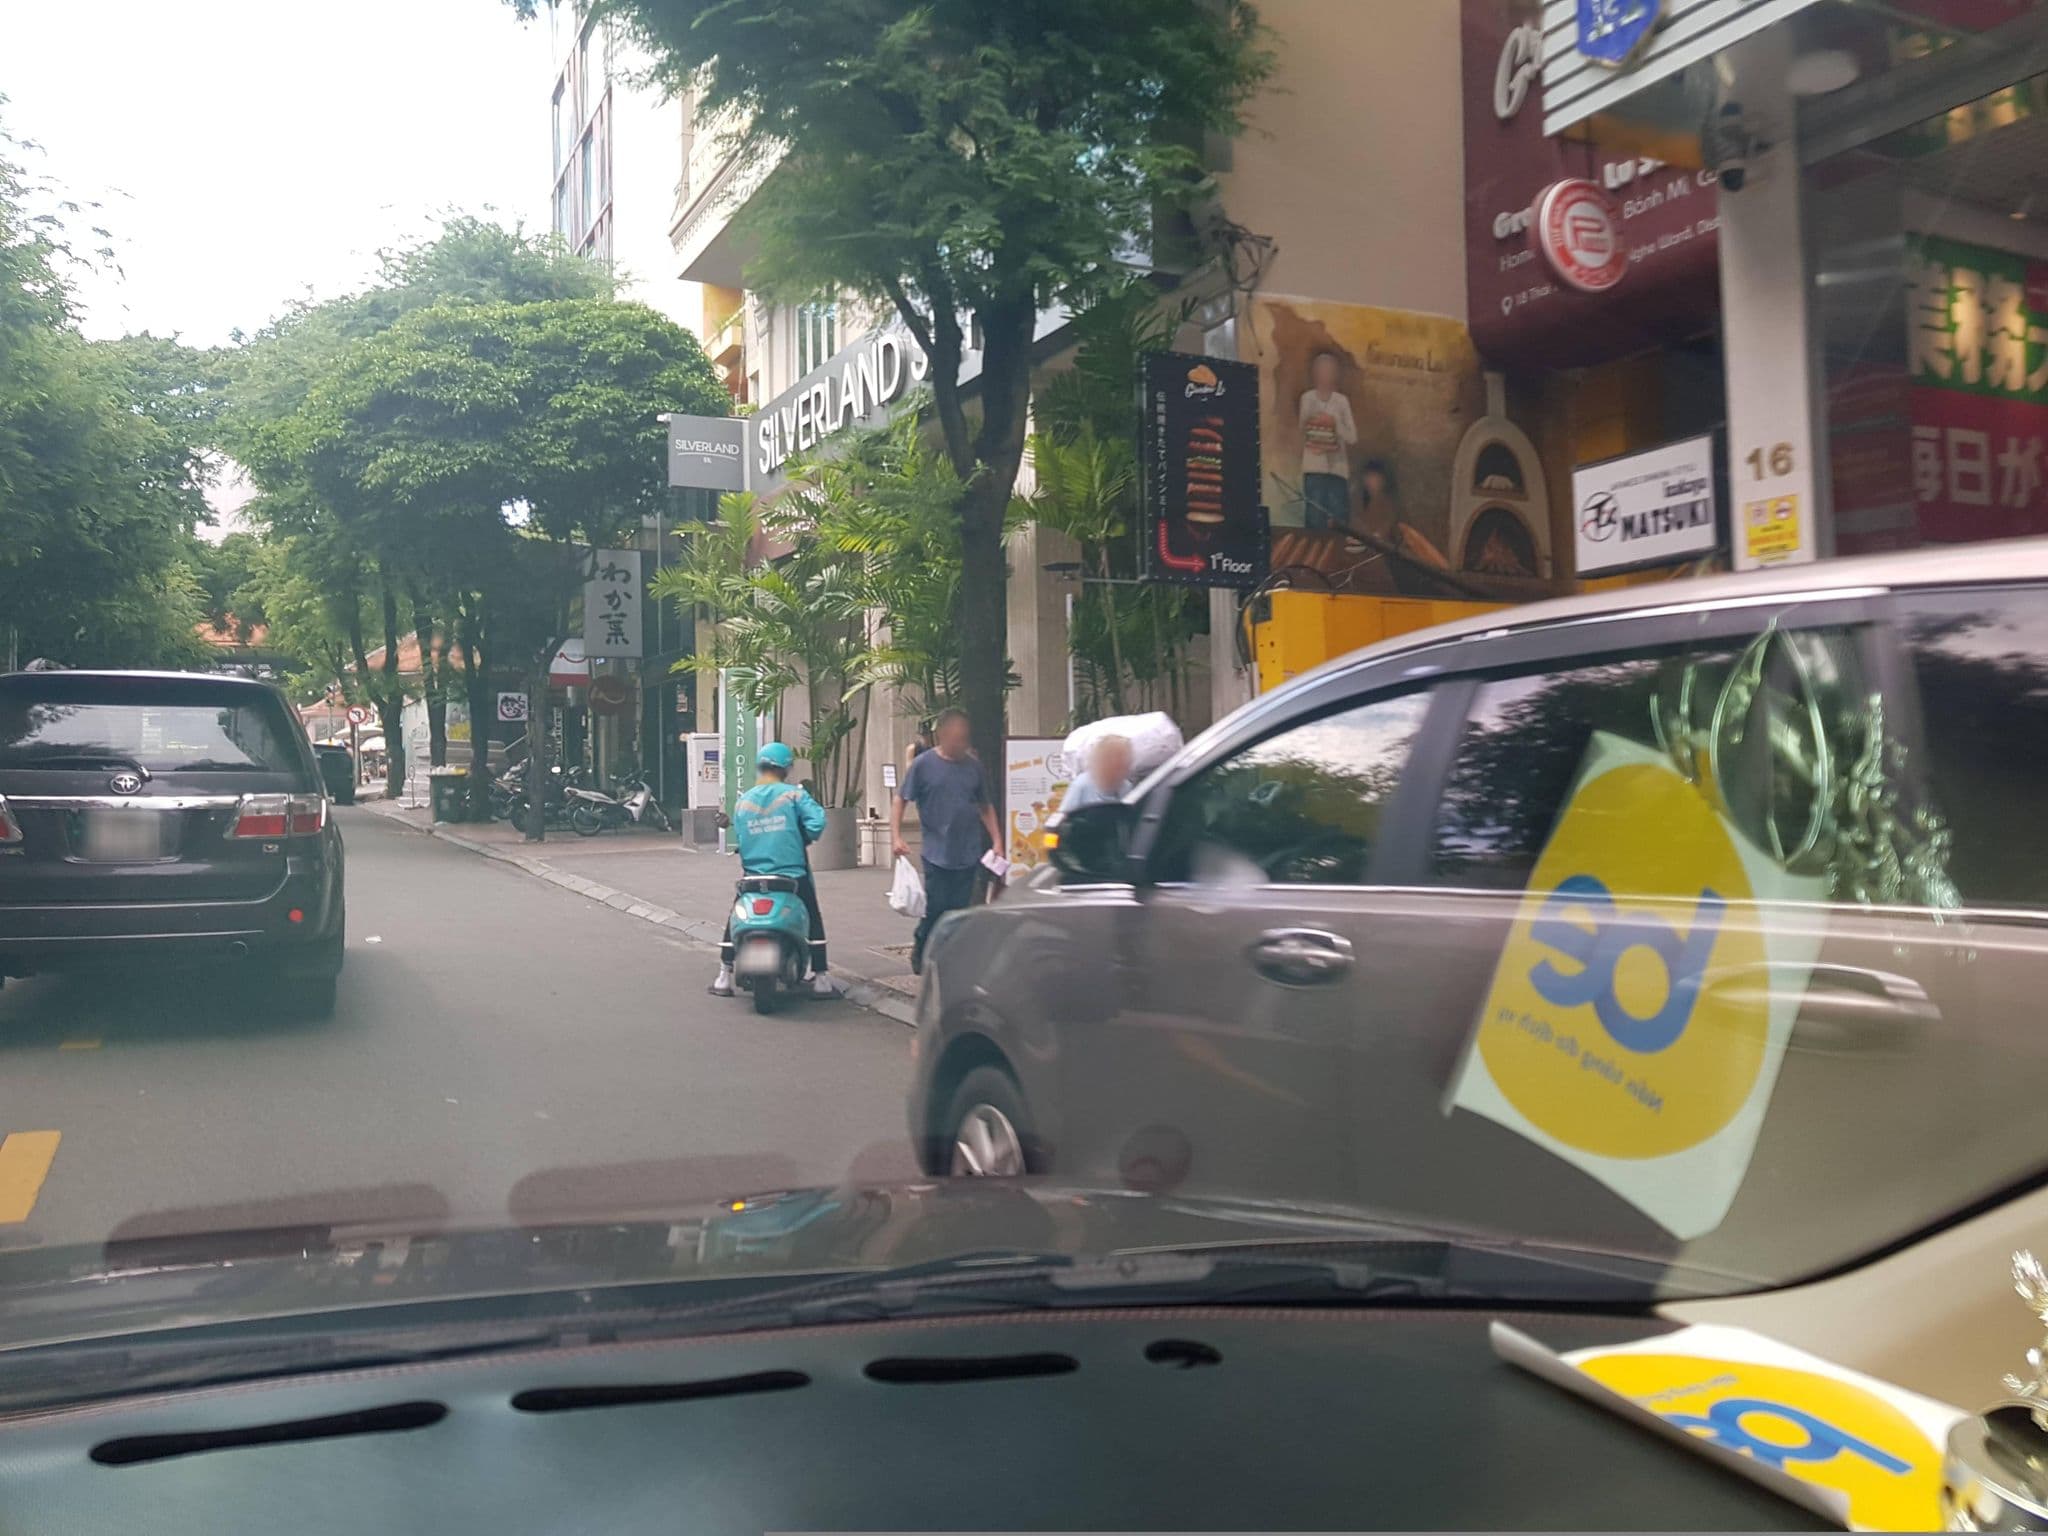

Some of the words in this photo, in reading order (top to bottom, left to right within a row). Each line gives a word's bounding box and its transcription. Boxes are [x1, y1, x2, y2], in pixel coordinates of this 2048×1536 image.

[758, 334, 902, 475] SILVERLAND
[675, 439, 740, 455] SILVERLAND
[1746, 441, 1794, 481] 16
